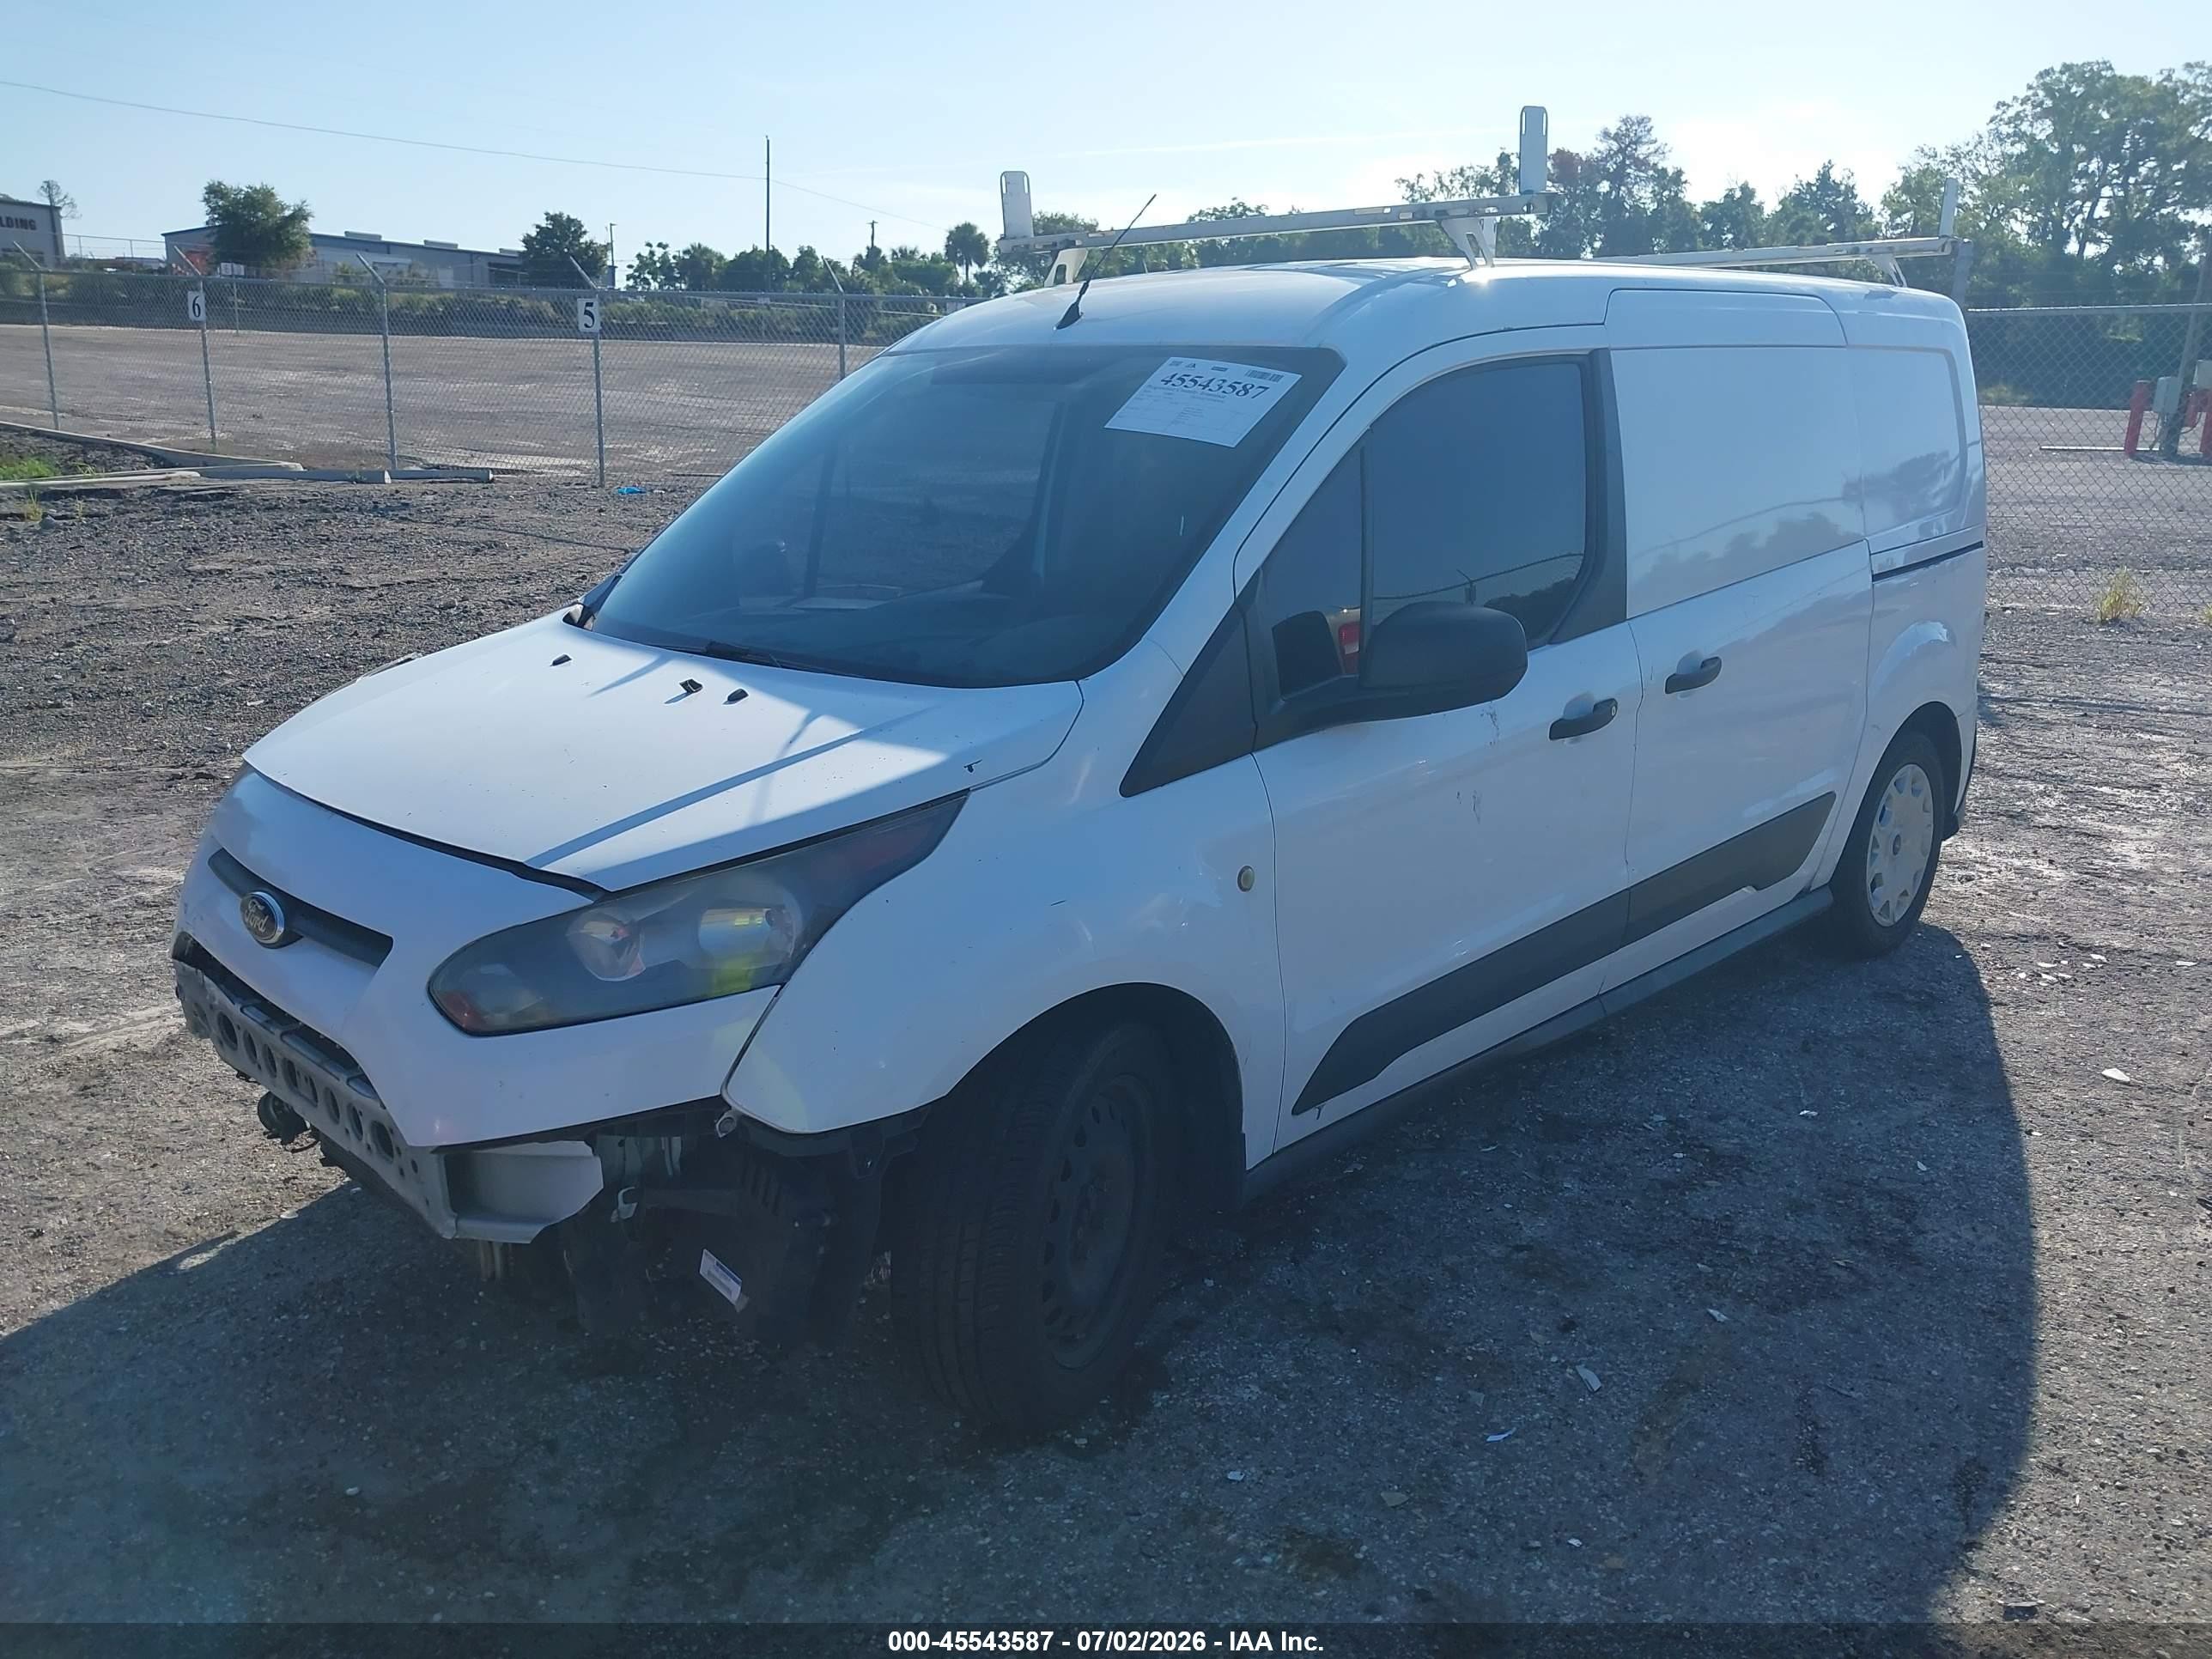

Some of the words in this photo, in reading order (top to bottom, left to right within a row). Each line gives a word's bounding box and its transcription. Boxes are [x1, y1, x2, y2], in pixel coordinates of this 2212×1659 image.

[192, 295, 201, 318] 6
[584, 301, 595, 328] 5
[1161, 372, 1270, 399] 45543587
[245, 898, 269, 933] Ford
